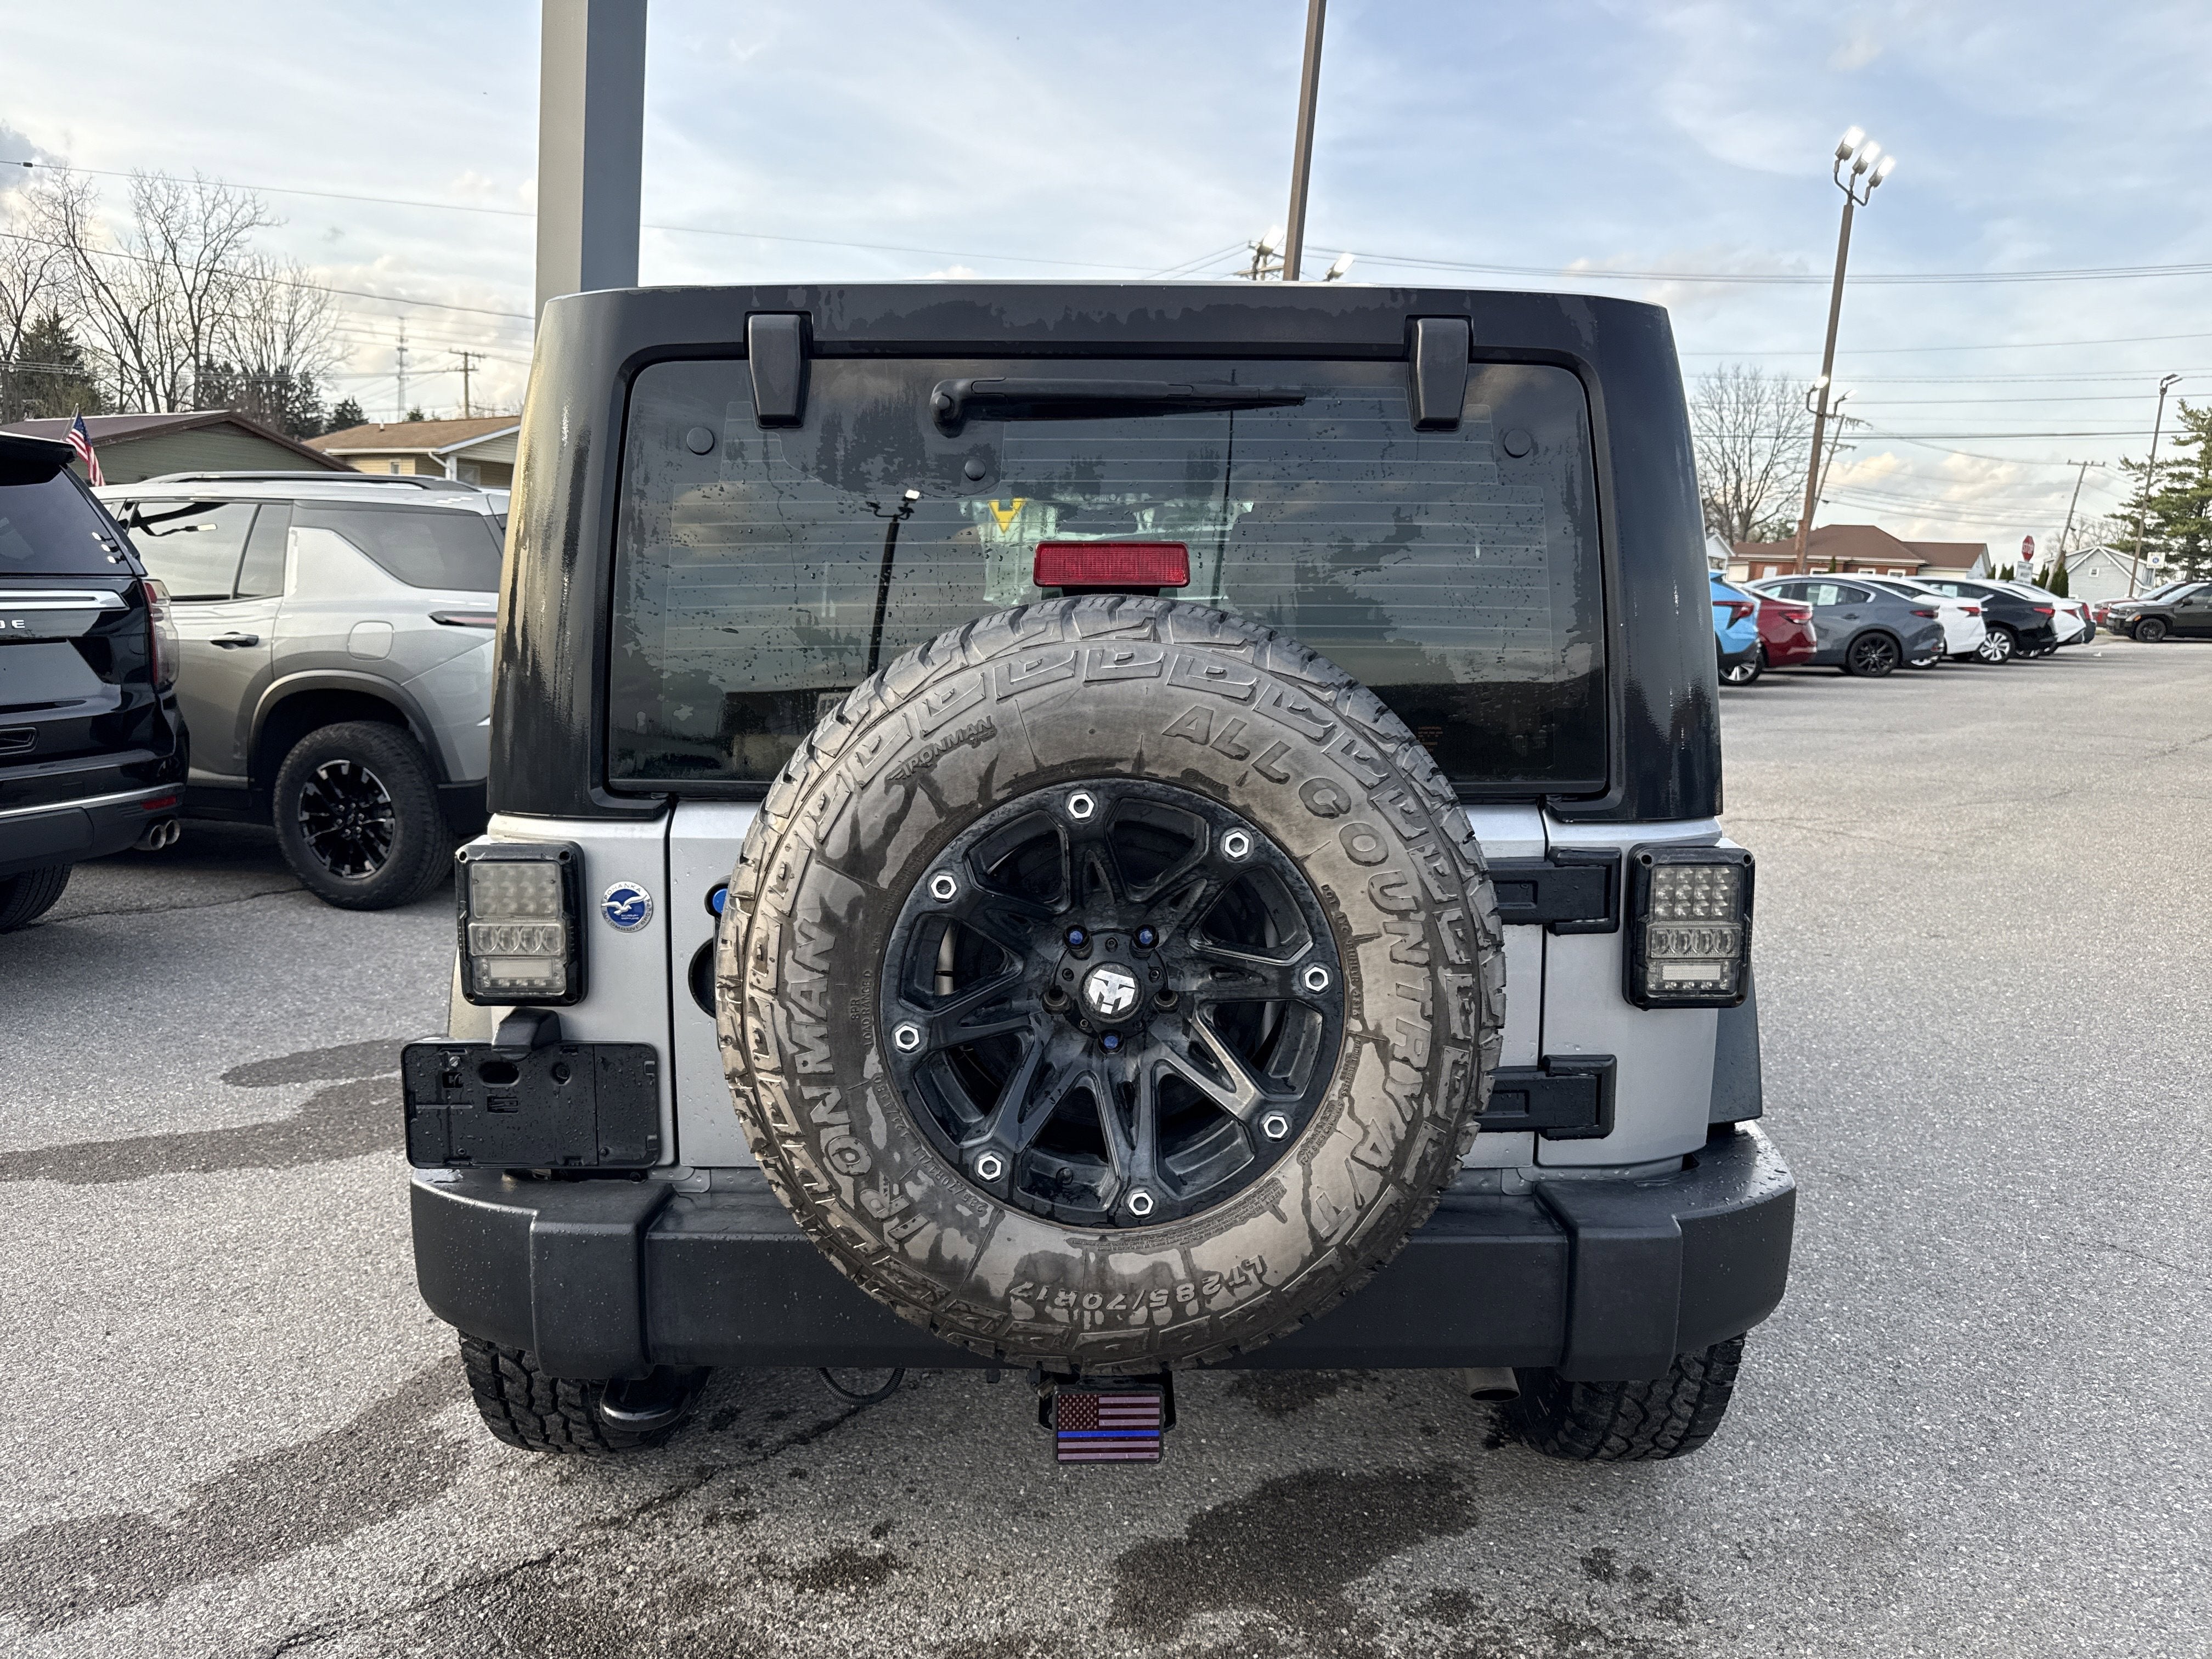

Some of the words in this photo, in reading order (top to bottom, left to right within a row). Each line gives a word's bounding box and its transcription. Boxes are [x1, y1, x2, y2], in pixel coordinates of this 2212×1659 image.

[900, 715, 992, 777] IRONMAN
[603, 883, 641, 900] POHANKA
[850, 998, 861, 1020] 8PR
[861, 979, 871, 1015] RANGE
[861, 1017, 873, 1046] LOAD
[790, 918, 929, 1242] IRONMAN
